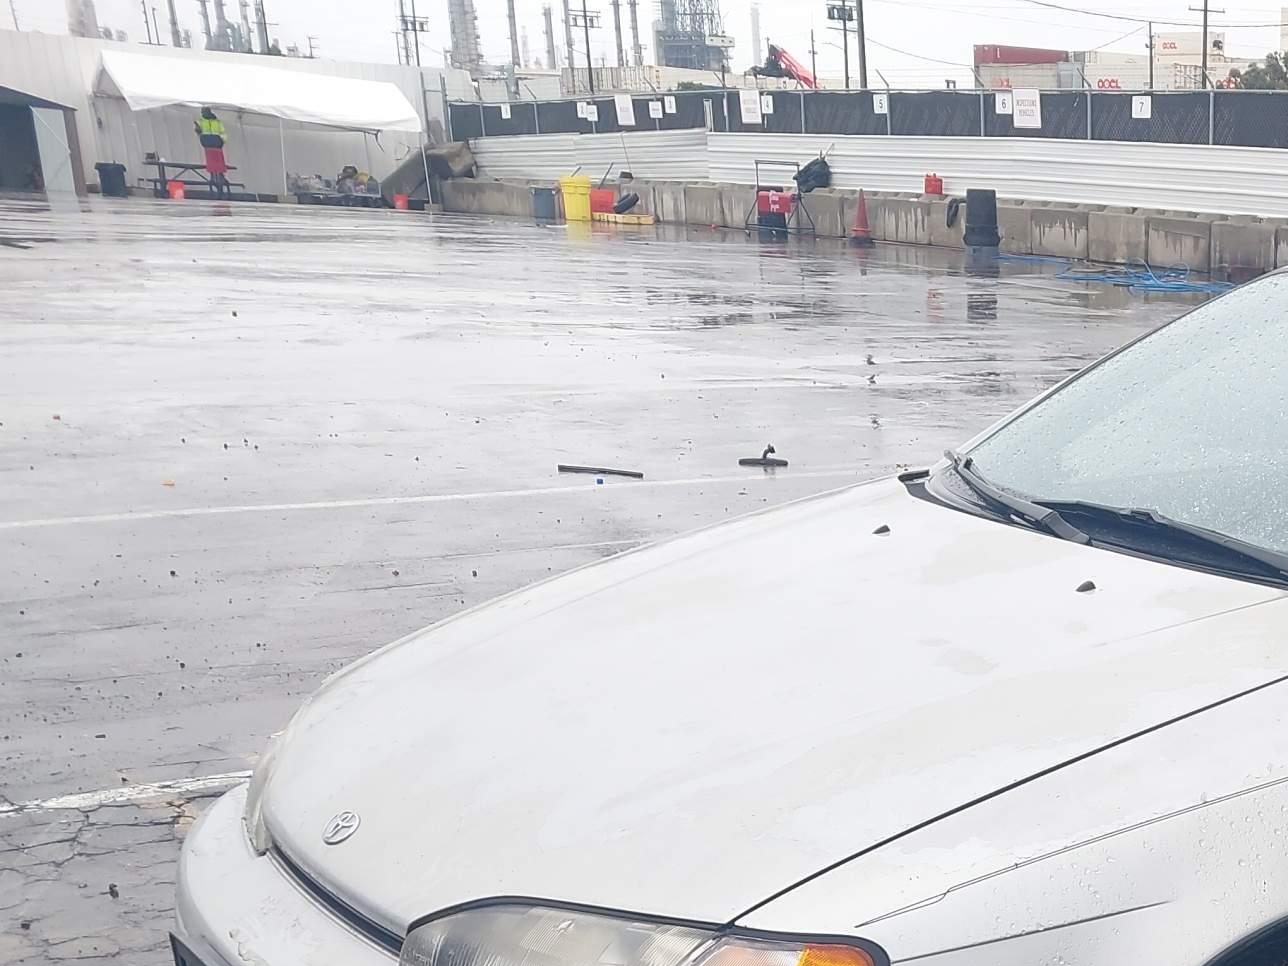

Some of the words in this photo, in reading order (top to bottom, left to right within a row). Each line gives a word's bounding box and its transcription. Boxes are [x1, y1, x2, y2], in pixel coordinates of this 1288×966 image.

[1097, 79, 1121, 89] OOCL
[878, 98, 884, 109] 5
[1001, 98, 1008, 110] 6
[1138, 102, 1145, 113] 7
